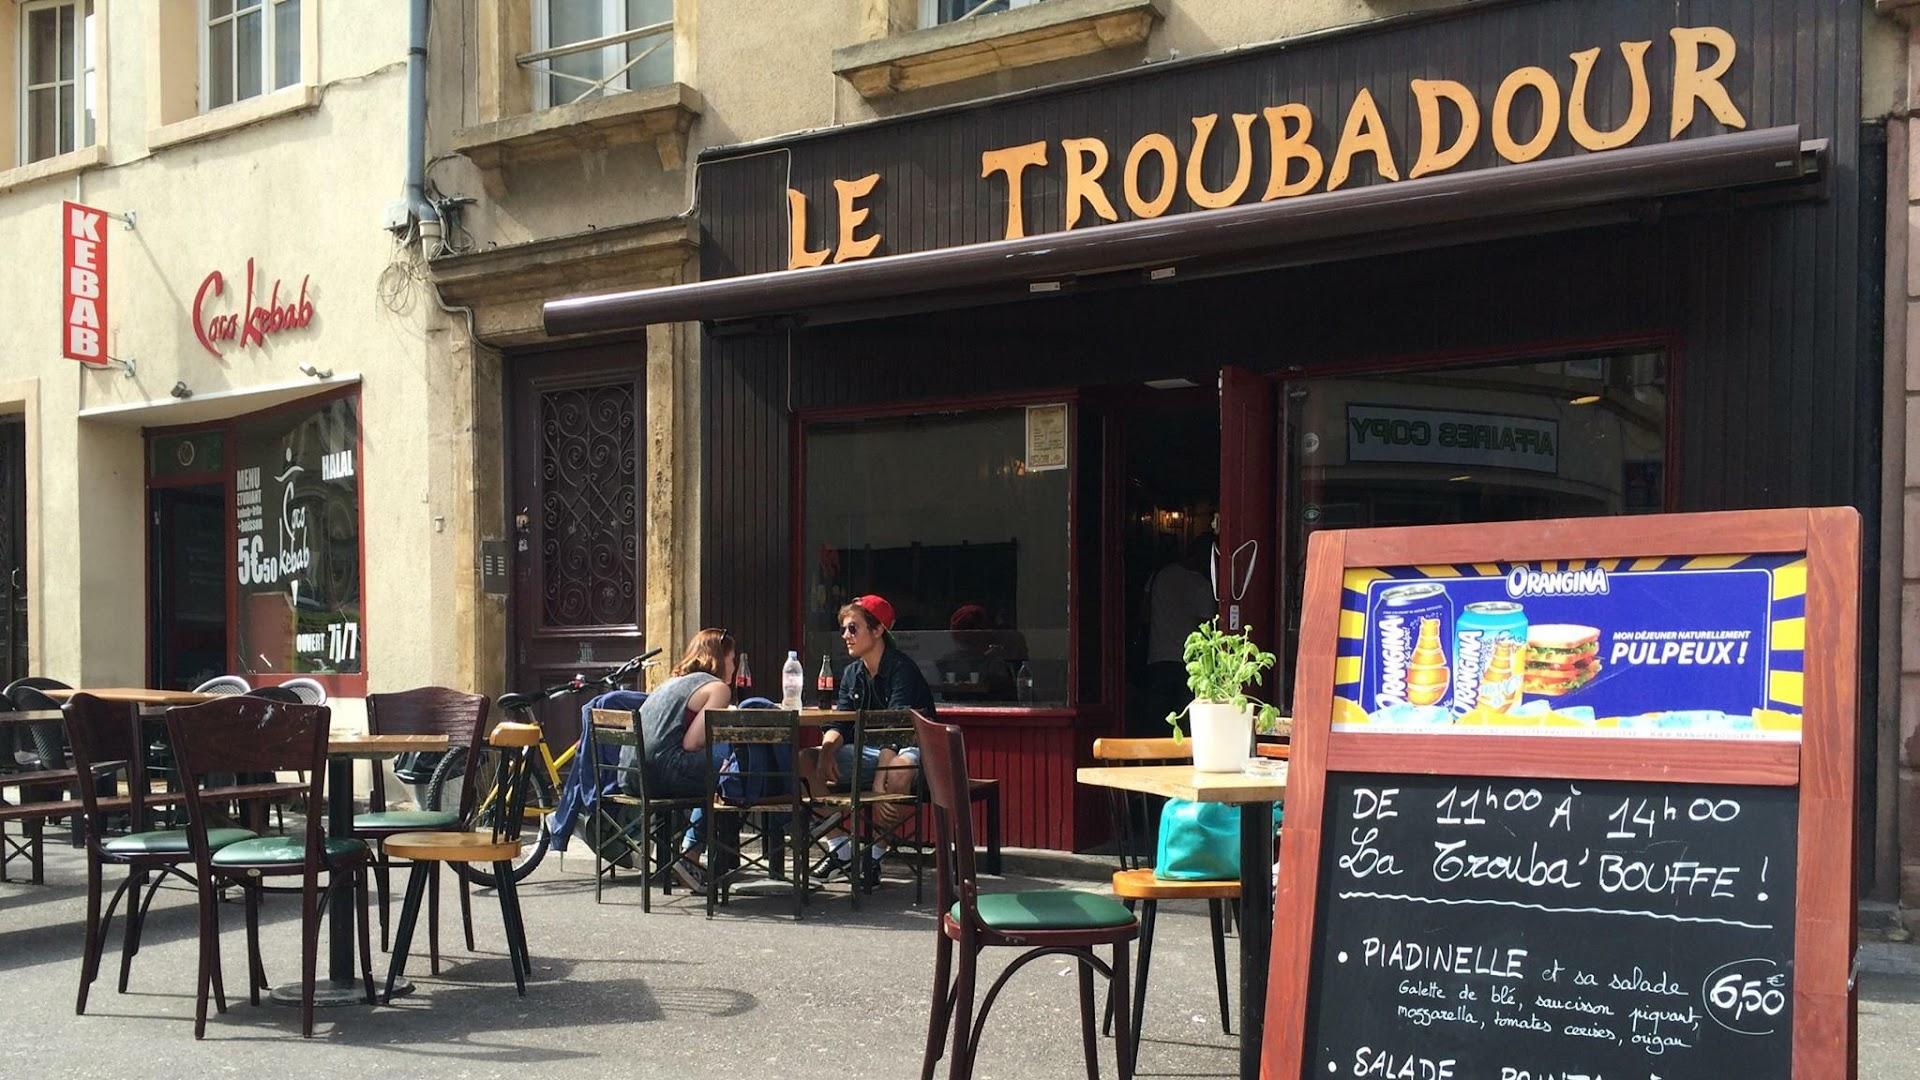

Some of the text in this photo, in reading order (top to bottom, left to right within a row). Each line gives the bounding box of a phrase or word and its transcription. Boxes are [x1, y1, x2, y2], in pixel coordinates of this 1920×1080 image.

[788, 26, 1747, 270] LE TROUBADOUR
[70, 208, 101, 357] KEBAB
[237, 467, 261, 491] MENU
[322, 449, 354, 481] HALAL
[1507, 566, 1608, 598] ORANGINA
[296, 632, 326, 653] OUVERT
[1610, 641, 1735, 665] PULPEUX
[1613, 630, 1751, 641] MON DÉJEUNER NATURELLEMENT
[1353, 788, 1400, 819] DE
[1550, 784, 1582, 831] À
[1339, 827, 1404, 878] La
[1600, 854, 1741, 898] BOUFFE
[1362, 937, 1689, 996] PIADINELLE et sa salade
[1398, 979, 1446, 999] Galette
[1458, 983, 1477, 1001] de
[1534, 994, 1615, 1016] saucisson
[1493, 1010, 1552, 1032] tomates
[1631, 1030, 1692, 1055] origan
[1353, 1046, 1457, 1080] SALADE
